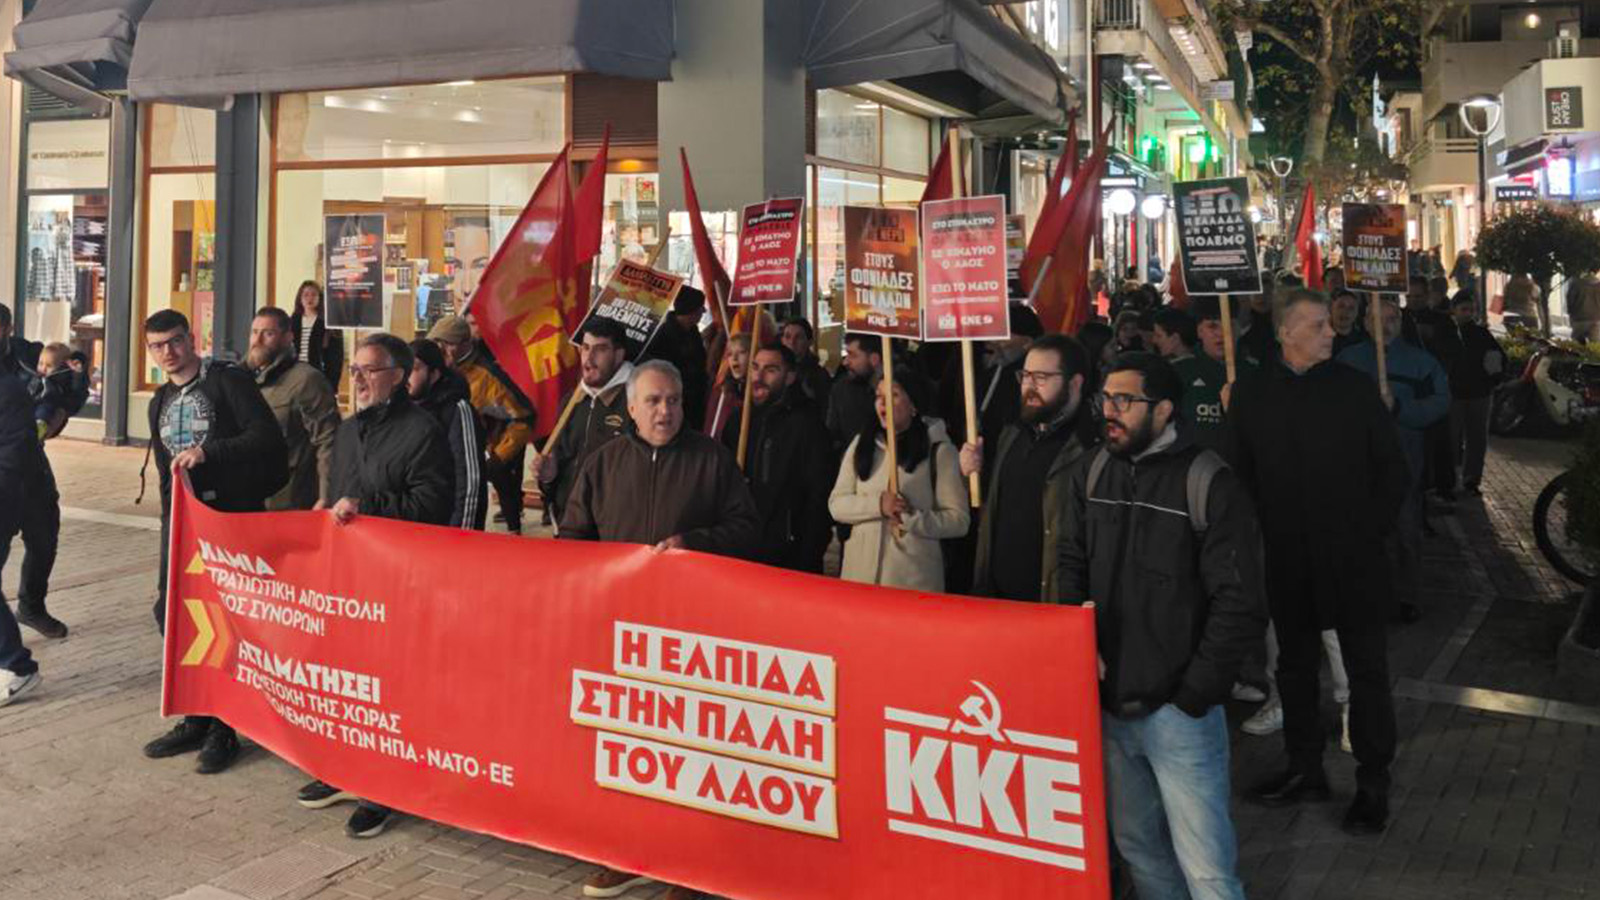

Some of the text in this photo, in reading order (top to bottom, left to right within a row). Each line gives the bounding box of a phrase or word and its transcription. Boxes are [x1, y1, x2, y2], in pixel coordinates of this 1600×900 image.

[1181, 194, 1242, 215] ΕΞΩ
[1184, 215, 1244, 226] Η ΕΛΛΑΔΑ
[1185, 224, 1245, 236] ΑΠΟ ΤΟΝ
[1185, 233, 1247, 247] ΠΟΛΕΜΟ
[1358, 234, 1384, 246] ΣΤΟΥΣ
[766, 257, 791, 266] ΝΑΤΟ
[863, 252, 895, 269] ΣΤΟΥΣ
[955, 258, 984, 268] ΛΑΟΣ
[1346, 246, 1402, 260] ΦΟΝΙΑΔΕΣ
[851, 268, 914, 291] ΦΟΝΙΑΔΕΣ
[953, 282, 966, 292] ΤΟ
[968, 280, 999, 291] ΝΑΤΟ
[854, 287, 873, 305] ΤΩΝ
[873, 290, 911, 310] ΛΑΩΝ
[595, 303, 654, 333] ΠΟΛΕΜΟΥΣ
[205, 565, 386, 623] ΤΡΑΤΙΩΤΙΚΗ ΑΠΟΣΤΟΛΗ
[248, 598, 326, 637] ΣΥΝΟΡΩΝ!
[621, 629, 826, 702] Η ΕΛΠΙΔΑ
[307, 692, 340, 719] ΤΗΣ
[341, 702, 402, 735] ΧΩΡΑΣ
[577, 678, 824, 763] ΣΤΗΝ ΠΑΛΗ
[339, 723, 376, 752] ΤΩΝ
[379, 736, 418, 764] ΗΠΑ
[427, 747, 479, 778] ΝΑΤΟ
[489, 762, 515, 787] ΕΕ
[602, 740, 826, 823] ΤΟΥ ΛΑΟΥ
[884, 727, 1086, 850] ΚΚΕ
